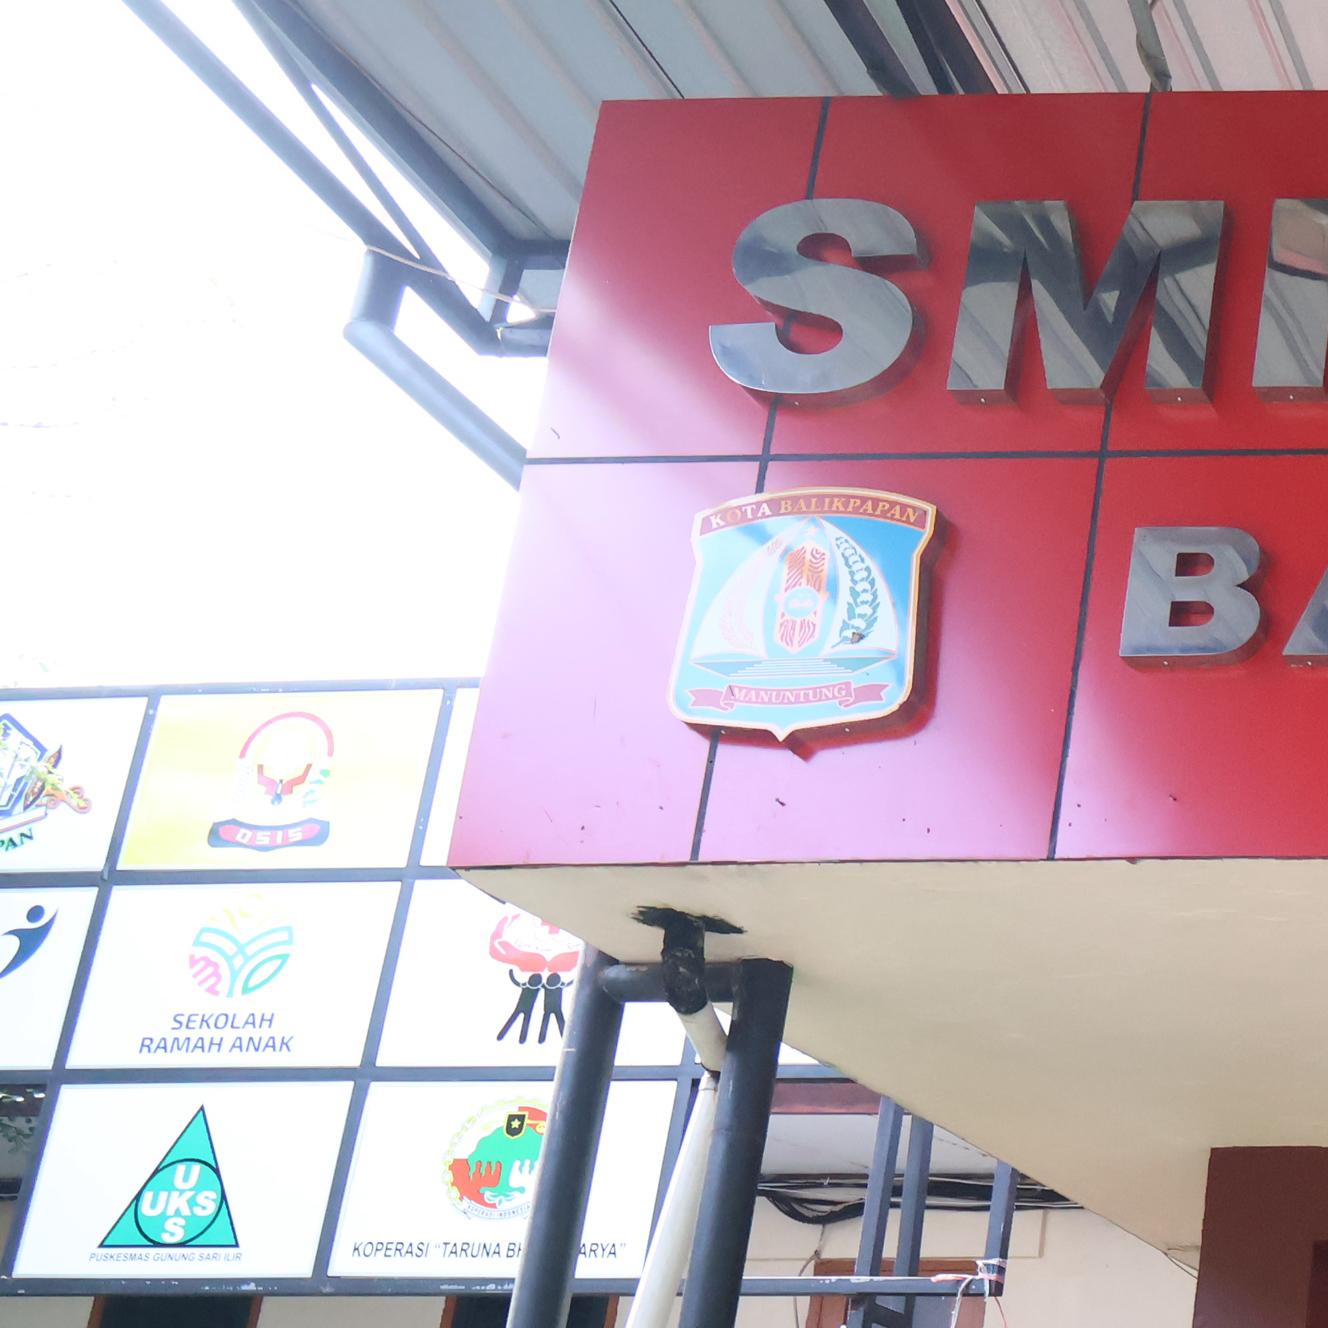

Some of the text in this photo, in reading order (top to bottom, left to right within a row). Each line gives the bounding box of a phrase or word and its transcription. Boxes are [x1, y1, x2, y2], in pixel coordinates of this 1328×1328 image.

[709, 498, 919, 529] KOTA BALIKPAPAN
[731, 684, 848, 704] MANUNTUNG
[235, 827, 304, 845] OSIS
[171, 1012, 275, 1031] SEKOLAH
[139, 1036, 294, 1054] RAMAH ANAK
[141, 1190, 218, 1217] UKS
[89, 1252, 243, 1262] PUSKESMAS GUNUNG SARI ILIR
[352, 1241, 429, 1259] KOPERASI
